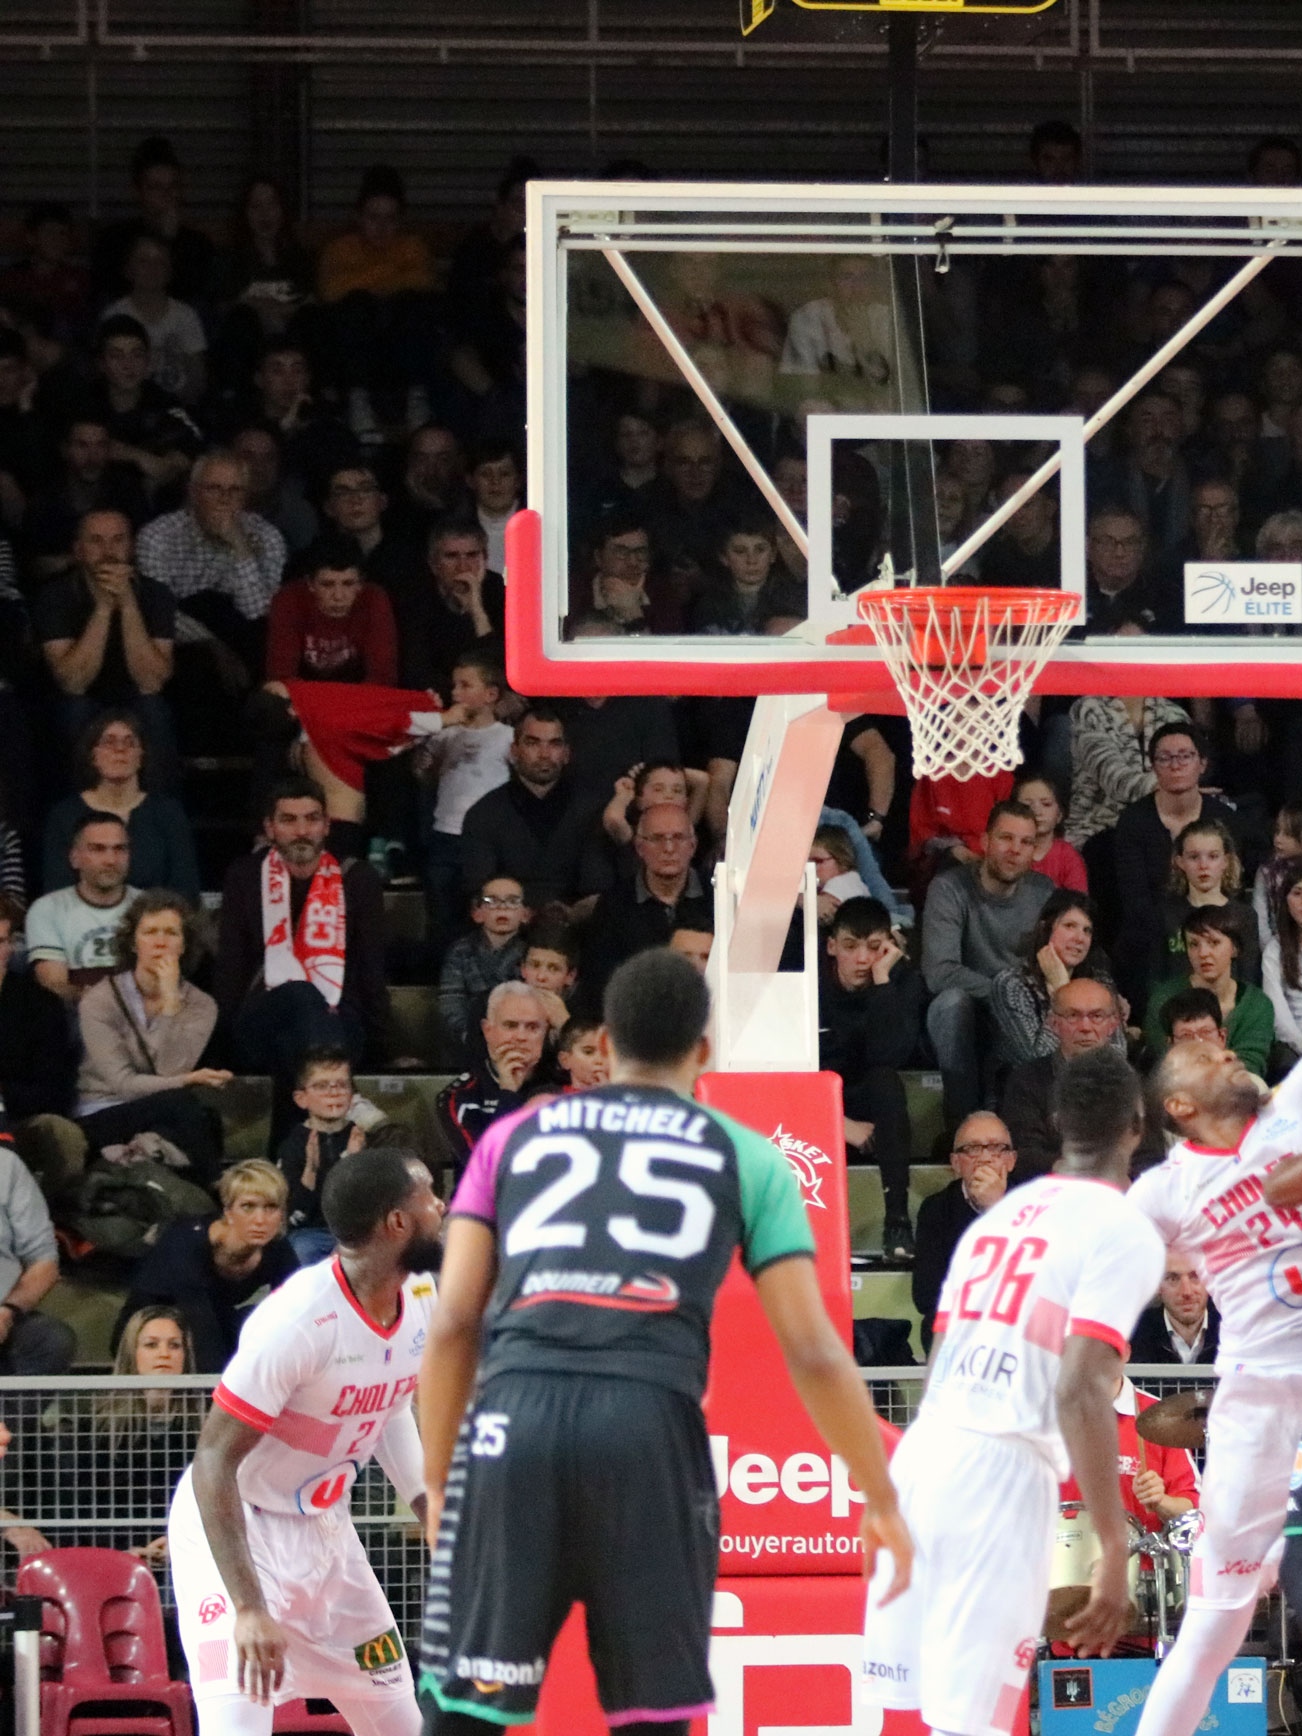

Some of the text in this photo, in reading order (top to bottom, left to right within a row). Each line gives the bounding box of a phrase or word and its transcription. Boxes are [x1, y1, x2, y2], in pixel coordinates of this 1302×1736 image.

[1240, 577, 1296, 600] Jeep
[1244, 599, 1293, 616] ÉLITE
[538, 1098, 708, 1143] MITCHELL
[507, 1135, 724, 1260] 25
[1011, 1204, 1049, 1228] SY
[956, 1235, 1049, 1327] 26
[346, 1420, 376, 1456] 2
[310, 1473, 347, 1509] U
